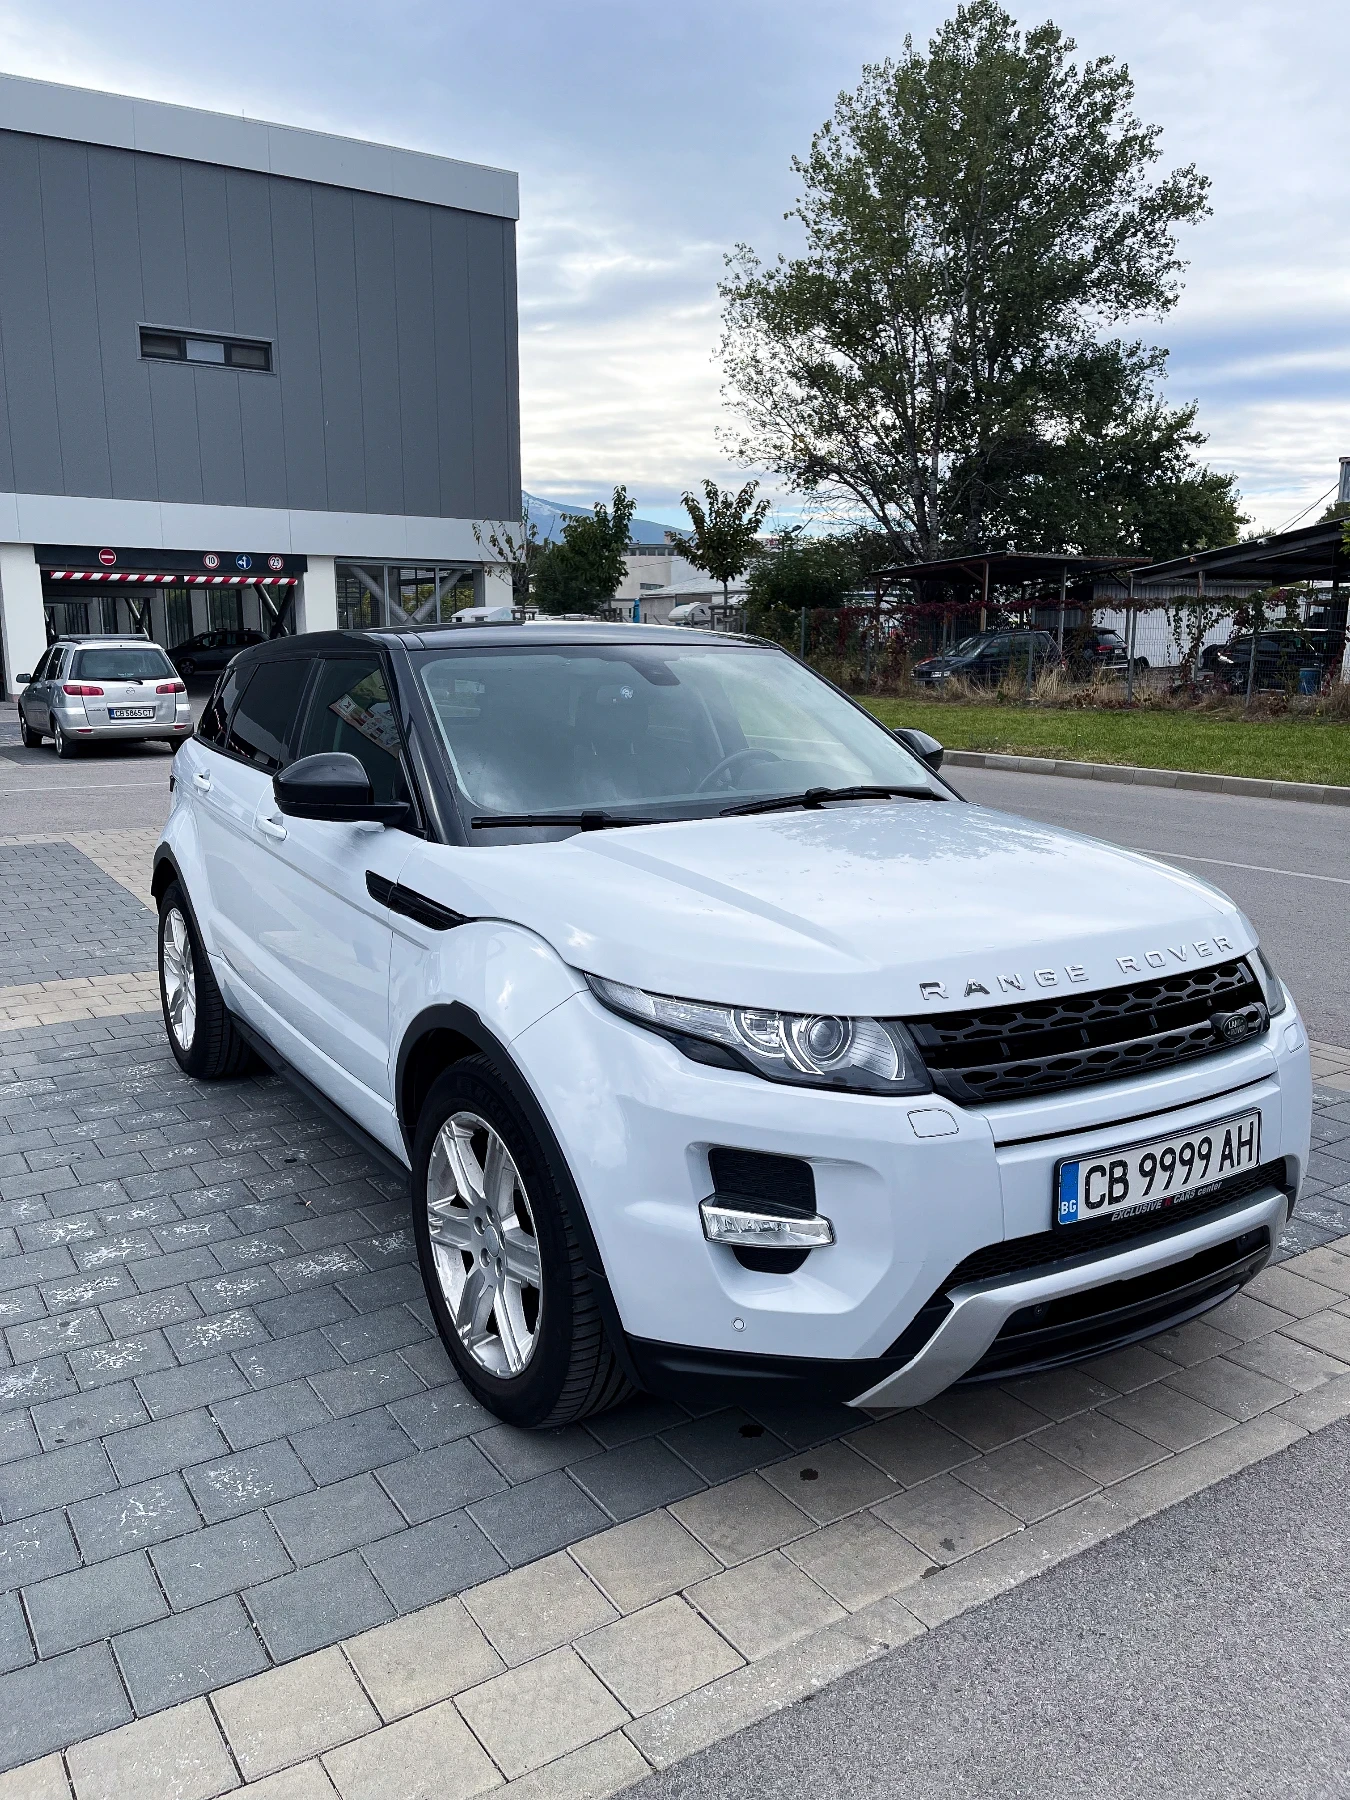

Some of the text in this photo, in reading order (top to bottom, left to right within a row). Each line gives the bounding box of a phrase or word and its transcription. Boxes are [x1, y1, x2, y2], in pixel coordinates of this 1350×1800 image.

[207, 556, 215, 565] 10
[125, 709, 142, 717] 5865
[142, 709, 152, 717] CT
[919, 935, 1234, 1000] RANGE ROVER
[1084, 1121, 1254, 1210] CB 9999 AH
[1060, 1199, 1077, 1215] BG
[1110, 1200, 1163, 1221] EXCLUSIVE
[1173, 1190, 1196, 1204] CARS
[1197, 1181, 1222, 1196] center
